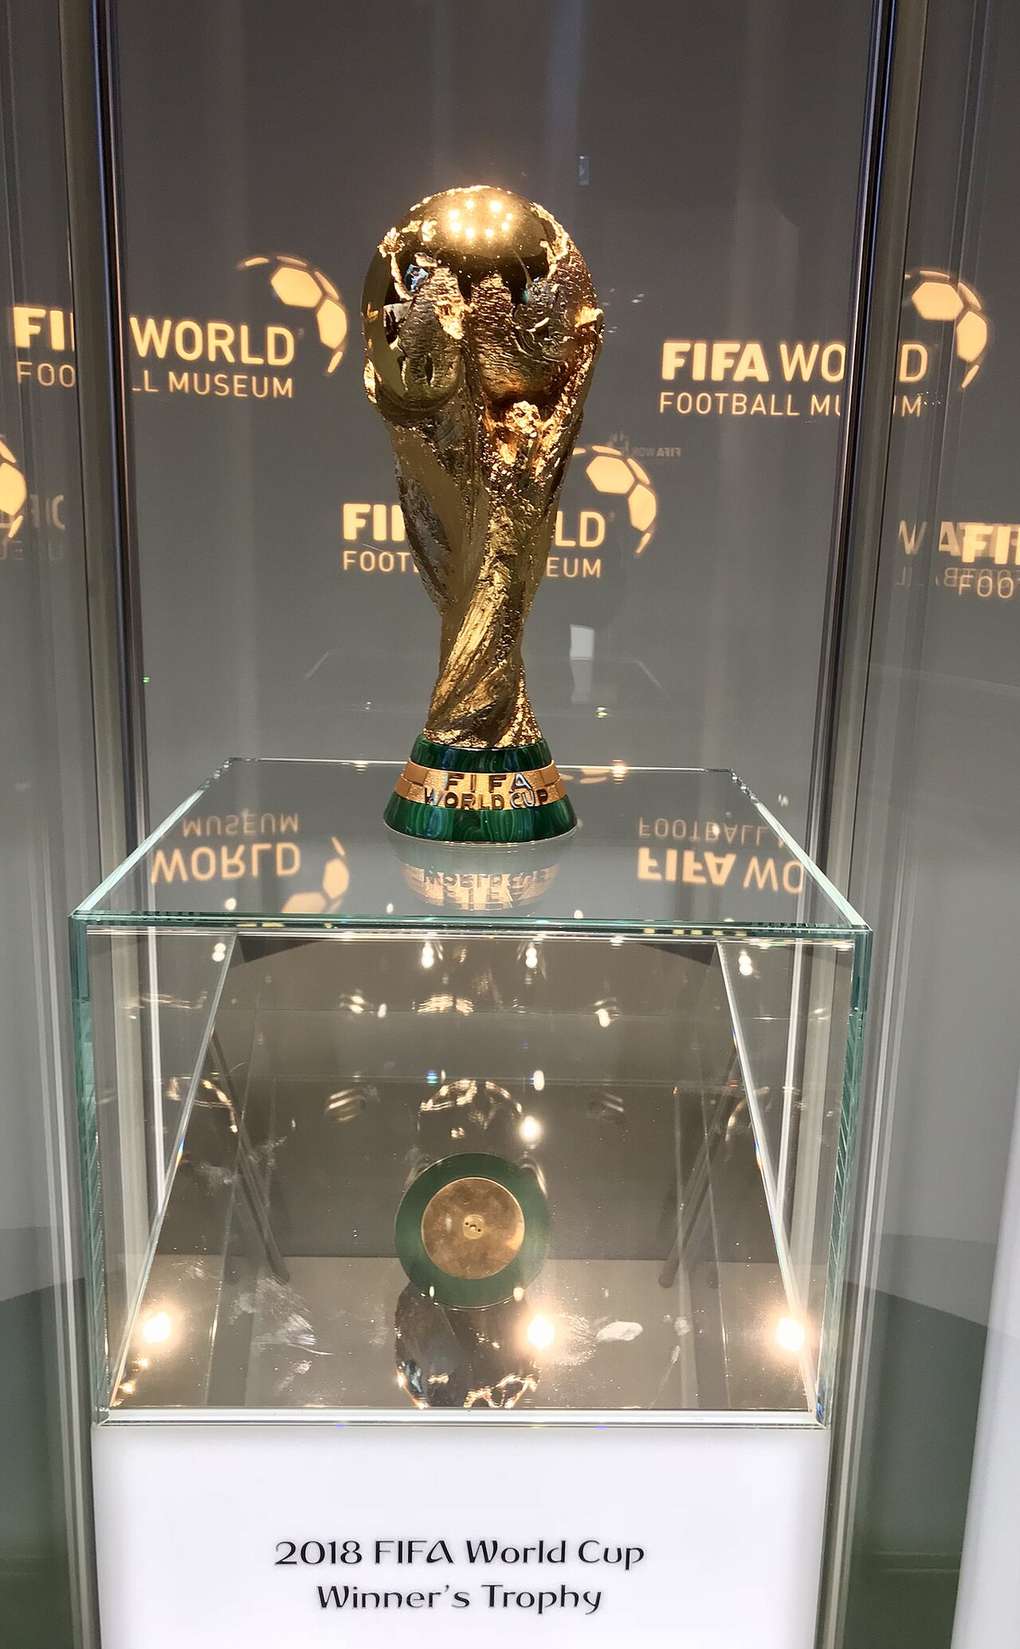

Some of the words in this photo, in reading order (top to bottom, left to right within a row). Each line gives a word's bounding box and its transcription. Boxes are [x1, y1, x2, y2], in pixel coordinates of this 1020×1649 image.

[13, 306, 75, 352] FI
[129, 316, 295, 366] WORLD
[661, 343, 770, 382] FIFA
[168, 371, 293, 399] MUSEUM
[660, 392, 800, 416] FOOTBALL
[343, 550, 420, 573] FOOT
[546, 556, 602, 579] EUM
[444, 773, 532, 794] FIFA
[424, 787, 505, 810] WORLD
[509, 787, 549, 809] CUP
[274, 1540, 362, 1565] 2018
[374, 1540, 455, 1564] FIFA
[466, 1539, 566, 1564] World
[577, 1540, 645, 1570] Cup
[317, 1585, 470, 1609] Winner's
[481, 1584, 602, 1615] Trophy
